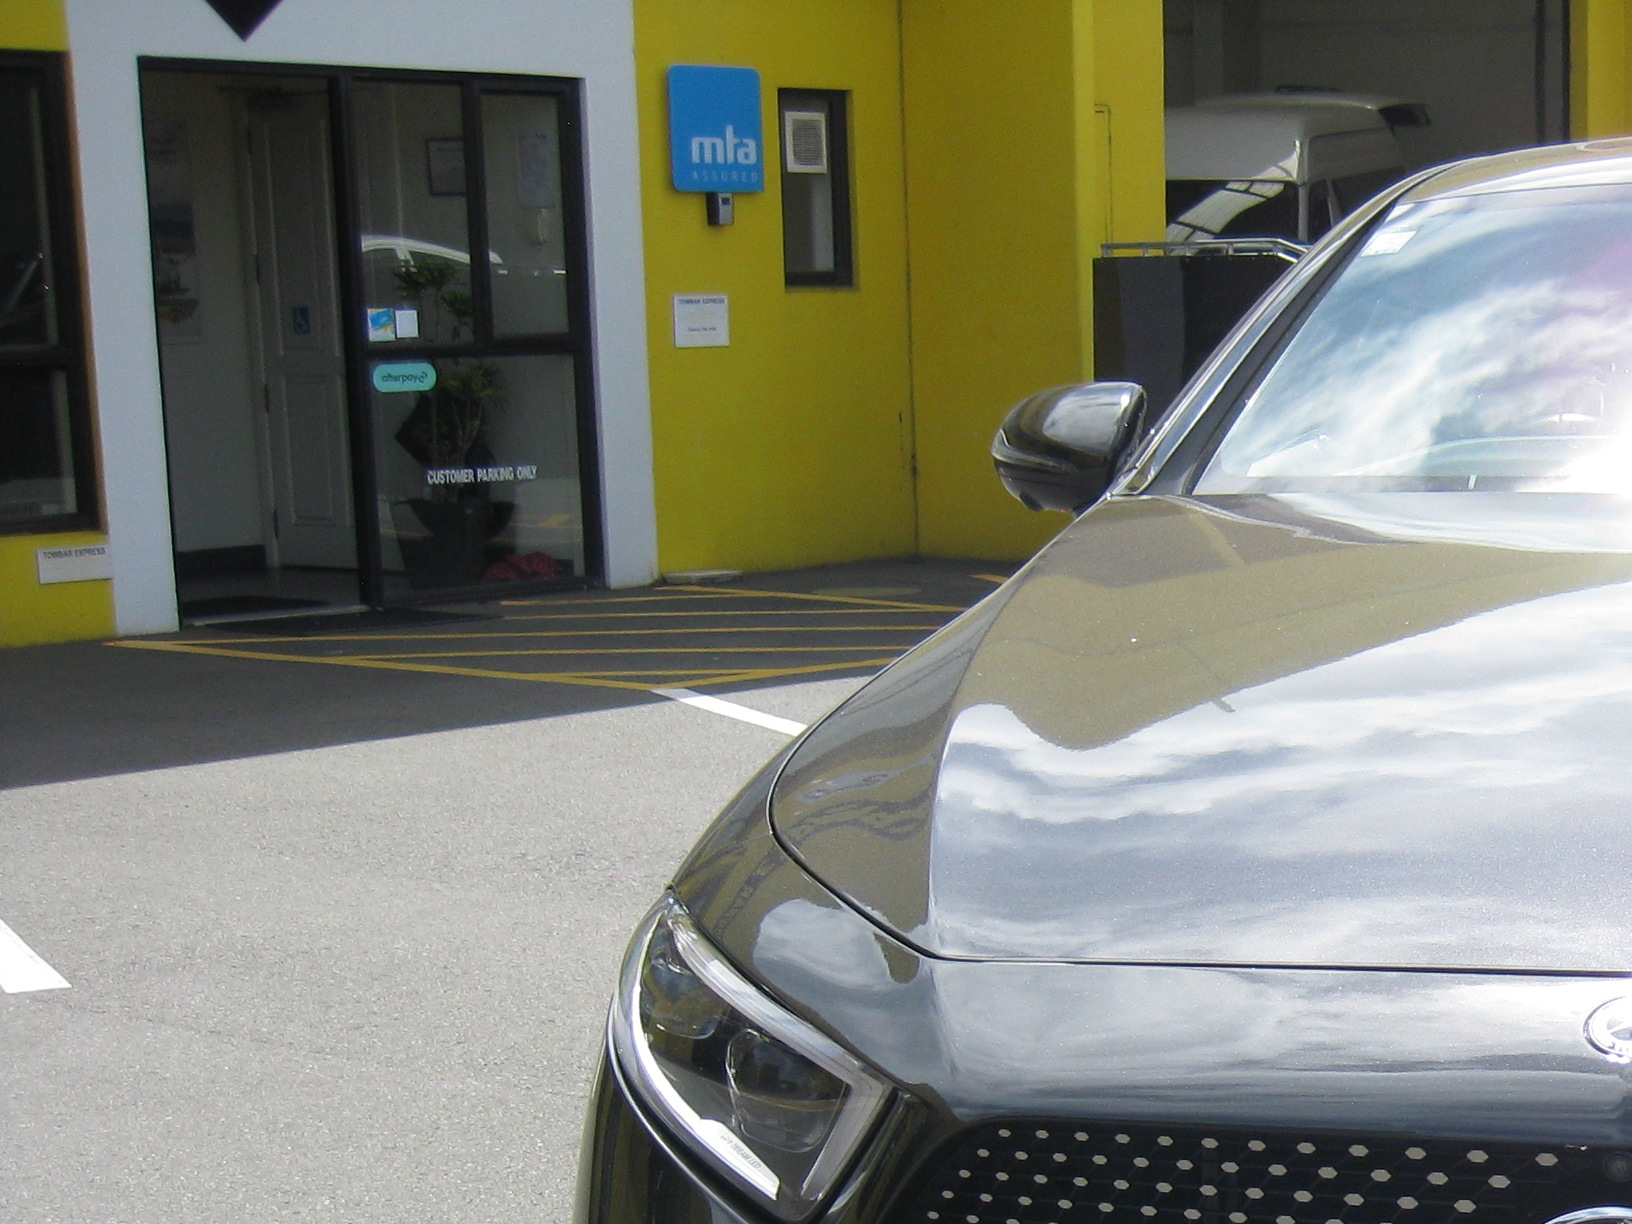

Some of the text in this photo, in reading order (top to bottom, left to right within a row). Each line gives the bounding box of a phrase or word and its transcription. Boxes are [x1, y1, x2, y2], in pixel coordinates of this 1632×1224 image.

[691, 124, 757, 165] mta
[692, 171, 758, 182] ASSURED
[381, 372, 418, 383] afterpay
[427, 464, 537, 485] CUSTOMER PARKING ONLY
